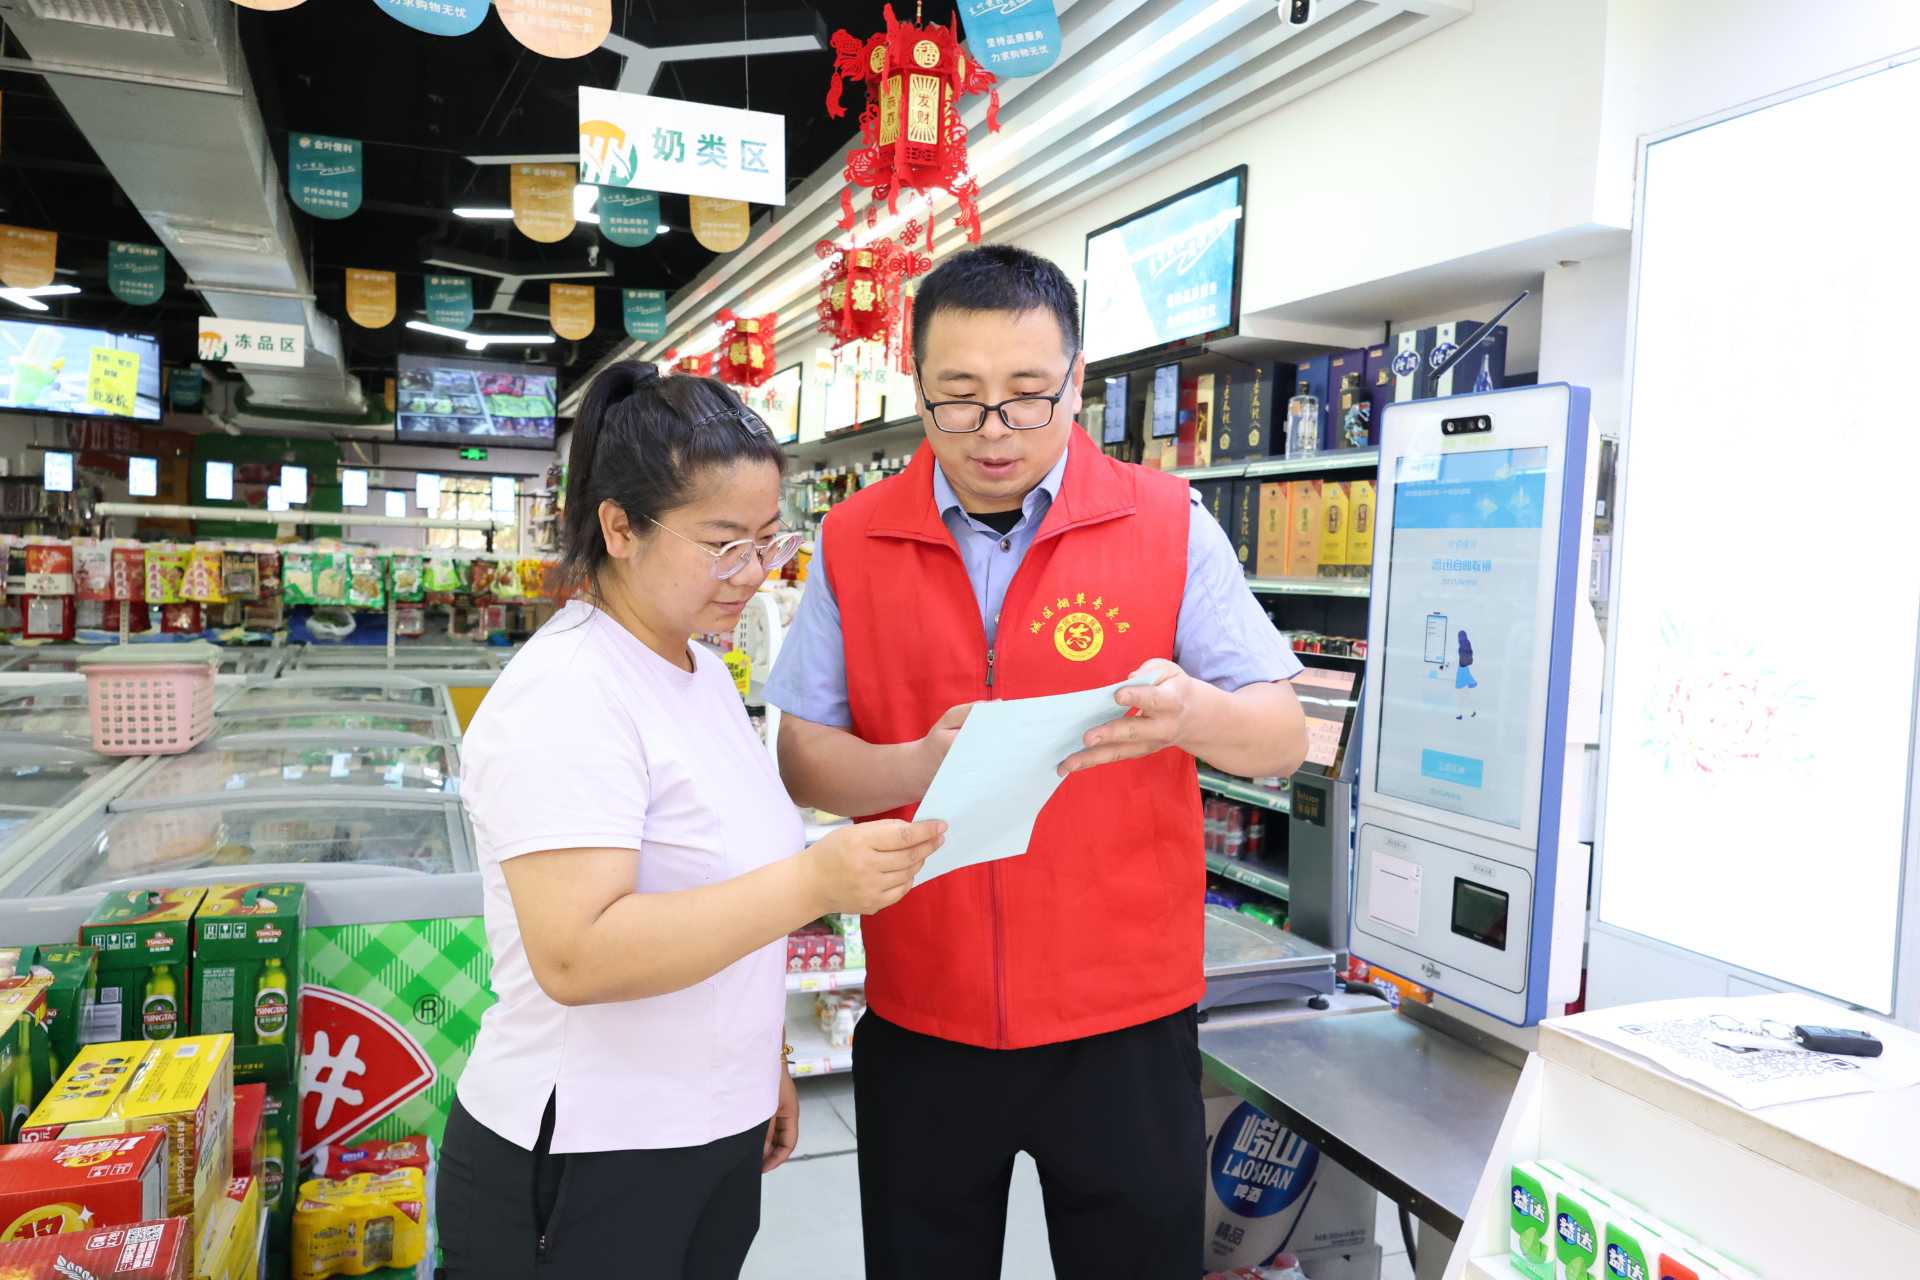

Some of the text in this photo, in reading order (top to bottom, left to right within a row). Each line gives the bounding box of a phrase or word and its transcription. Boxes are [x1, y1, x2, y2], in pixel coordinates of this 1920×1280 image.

[651, 126, 770, 174] 奶类区
[234, 332, 296, 353] 冻品区
[1233, 1113, 1309, 1169] 崂山
[1222, 1154, 1295, 1191] LAOSHAN
[1233, 1183, 1263, 1203] 啤酒
[1513, 1187, 1545, 1224] 益达
[1215, 1221, 1245, 1246] 精品
[1558, 1216, 1593, 1253] 益达
[1607, 1247, 1644, 1280] 益达
